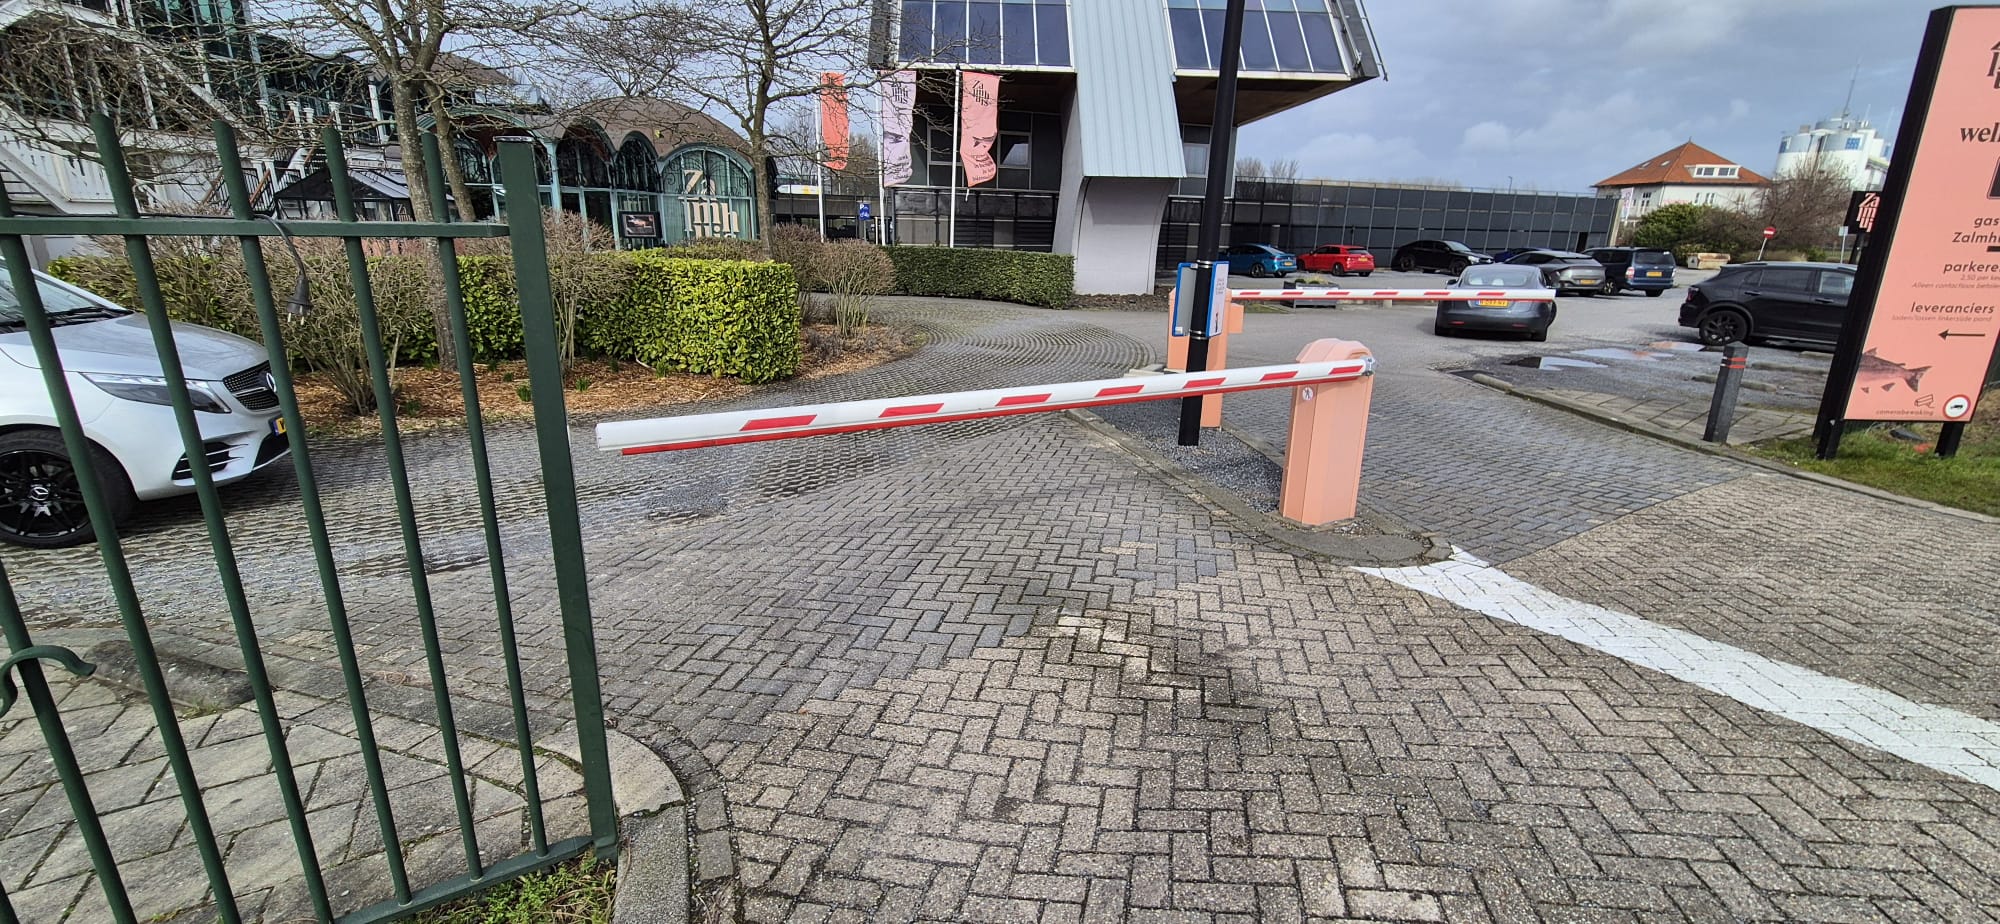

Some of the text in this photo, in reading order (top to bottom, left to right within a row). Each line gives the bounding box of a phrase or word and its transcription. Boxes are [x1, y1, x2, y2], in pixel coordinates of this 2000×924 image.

[1960, 121, 2000, 142] wel
[1952, 231, 2000, 243] Zalmh
[1943, 261, 2000, 274] parkere
[1911, 302, 1994, 314] leveranciers
